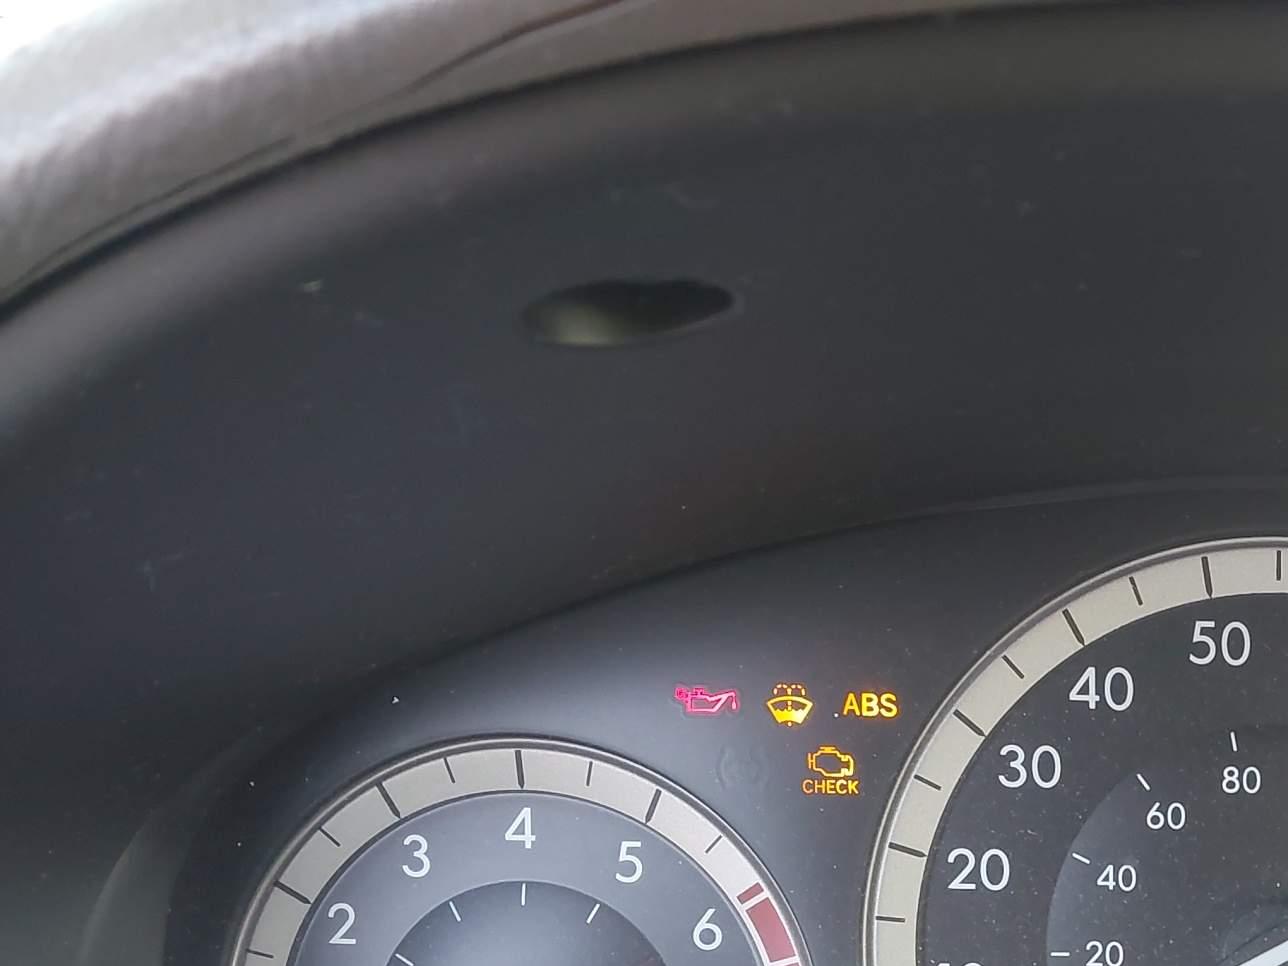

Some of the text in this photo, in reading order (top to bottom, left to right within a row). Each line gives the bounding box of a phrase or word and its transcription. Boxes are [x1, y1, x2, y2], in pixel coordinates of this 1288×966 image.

[1190, 621, 1250, 665] 50
[843, 693, 897, 717] ABS
[1069, 667, 1133, 711] 40
[802, 779, 859, 795] CHECK
[999, 745, 1061, 788] 30
[1222, 767, 1260, 793] 80
[505, 808, 536, 848] 4
[1147, 802, 1185, 829] 60
[403, 835, 430, 877] 3
[616, 841, 642, 882] 5
[948, 848, 1009, 890] 20
[1097, 865, 1136, 891] 40
[329, 903, 356, 944] 2
[693, 909, 722, 950] 6
[1086, 941, 1123, 966] 20
